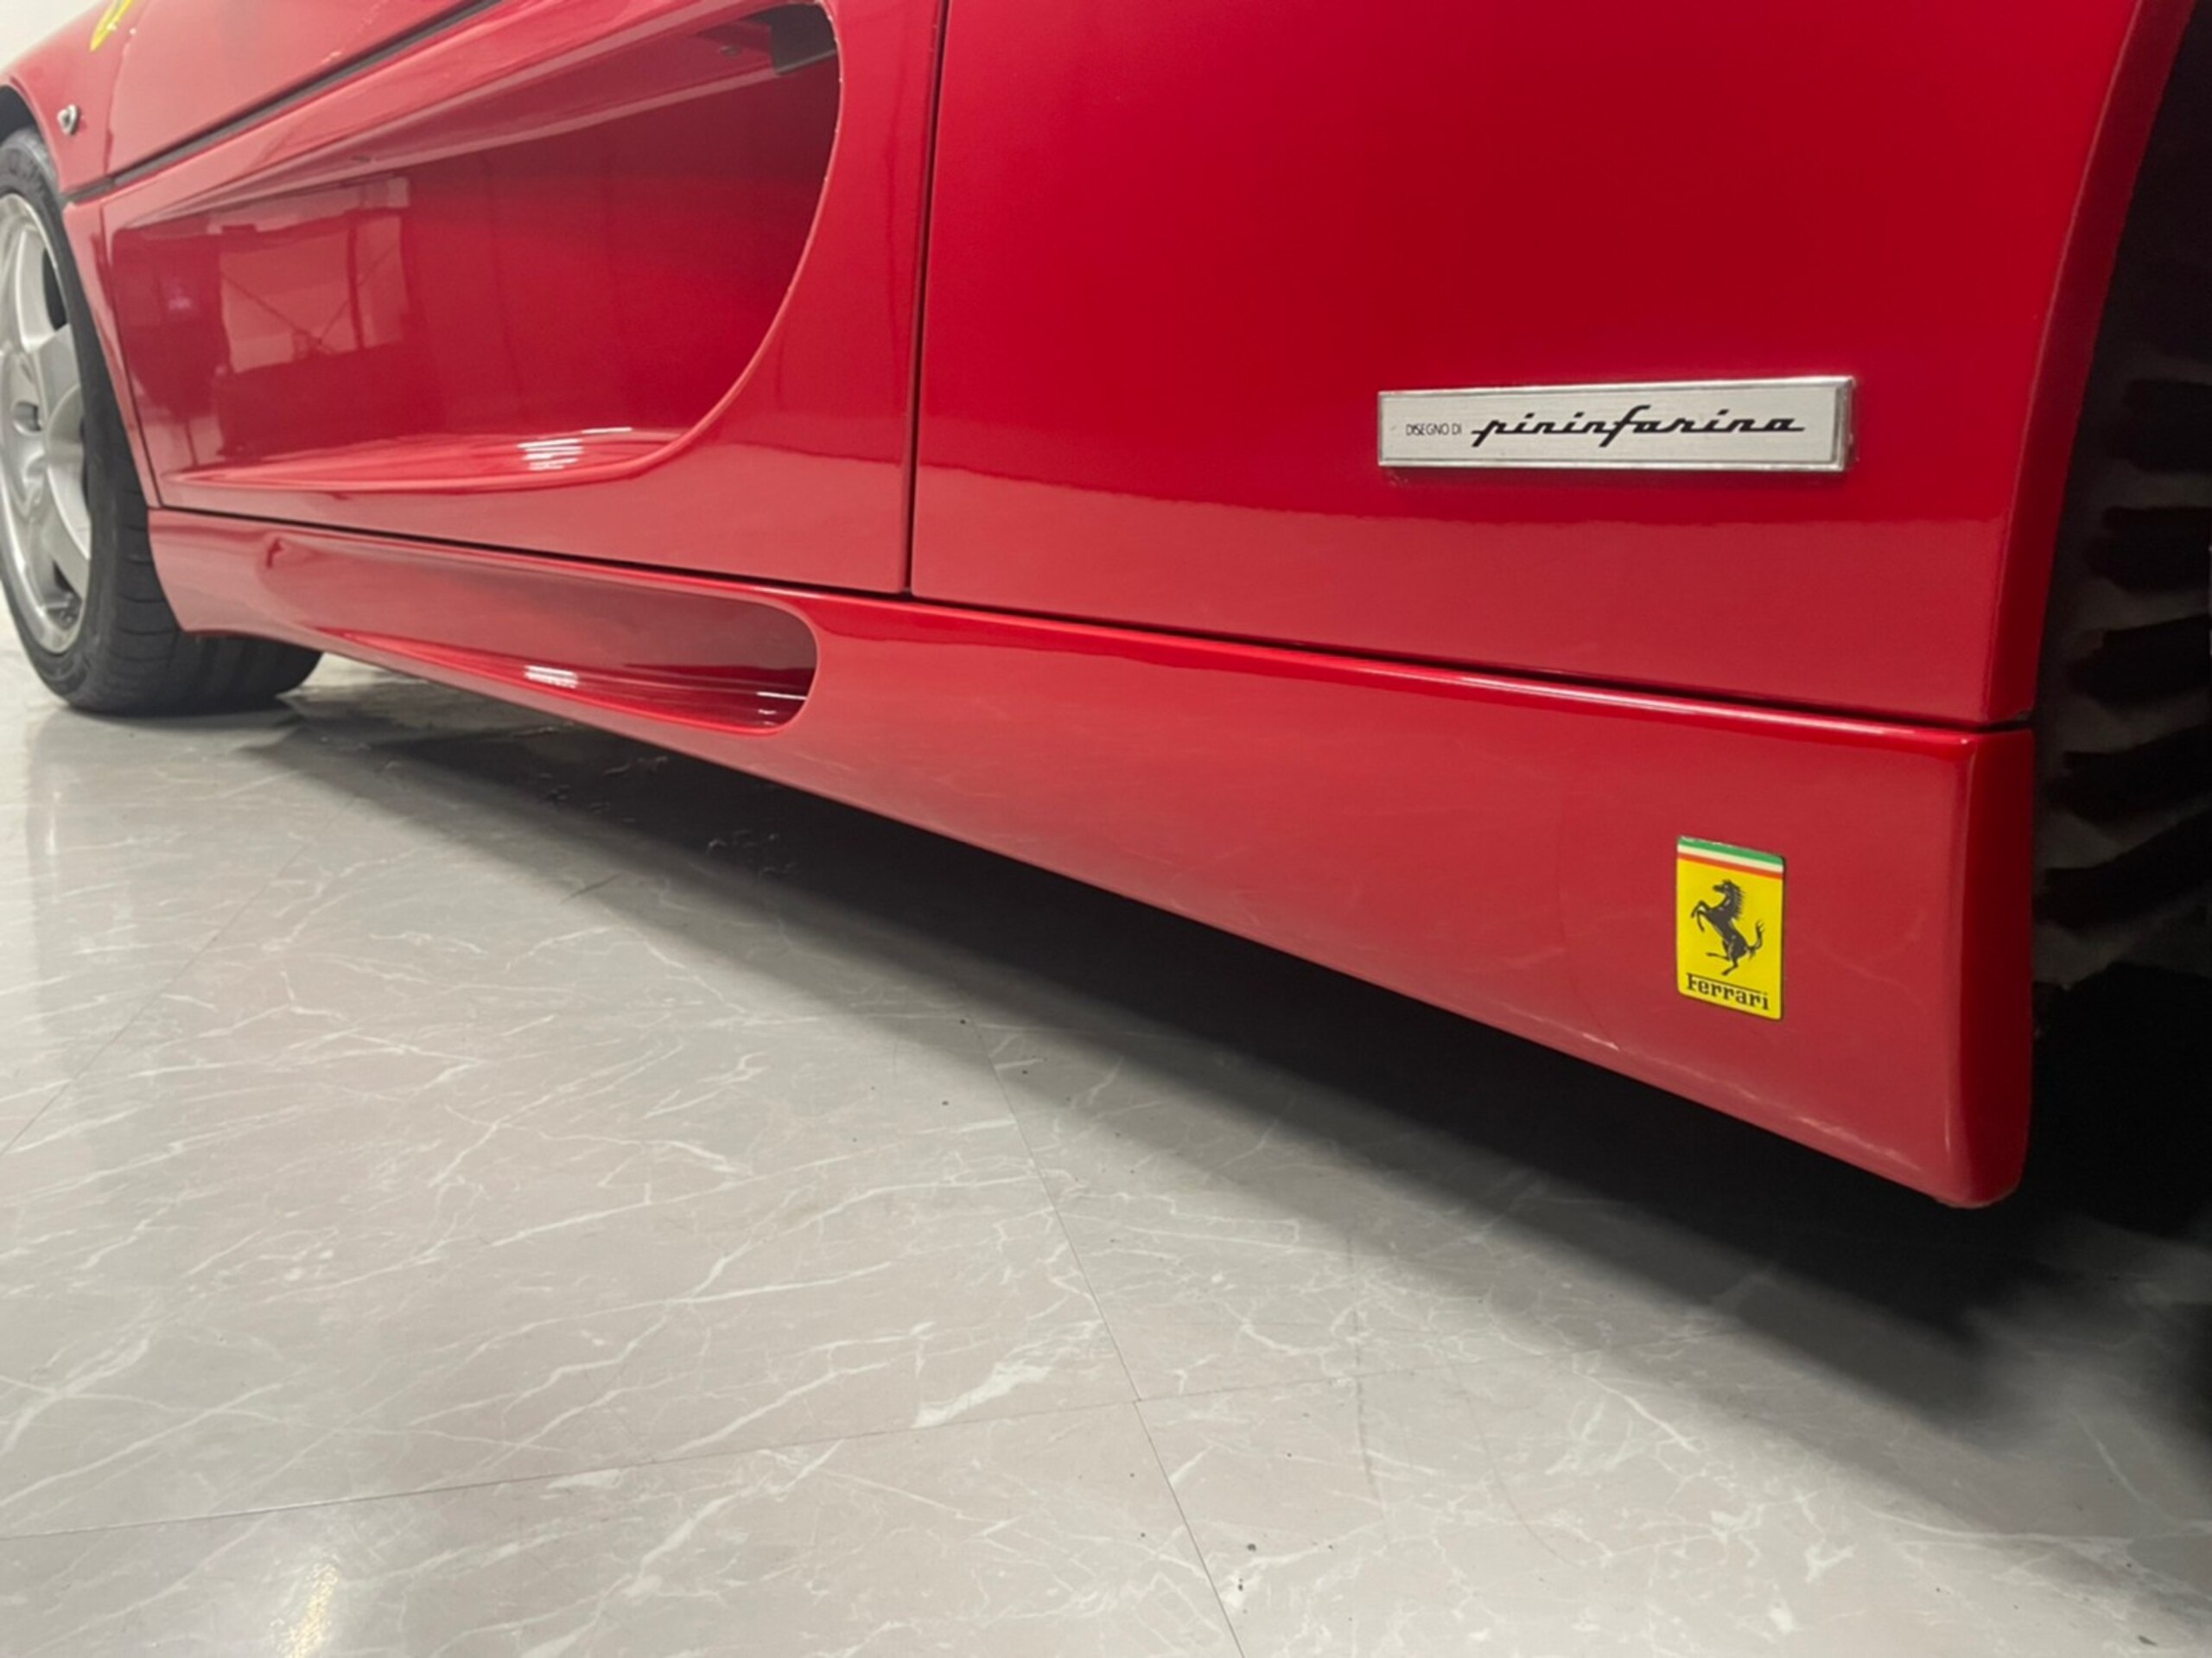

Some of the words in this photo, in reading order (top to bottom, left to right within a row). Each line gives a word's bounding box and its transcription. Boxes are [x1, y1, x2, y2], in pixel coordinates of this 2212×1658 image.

[1406, 422, 1449, 435] DISEGNO
[1452, 422, 1462, 435] DI
[1471, 404, 1805, 448] pininfarina
[1687, 972, 1769, 1010] Ferrari
